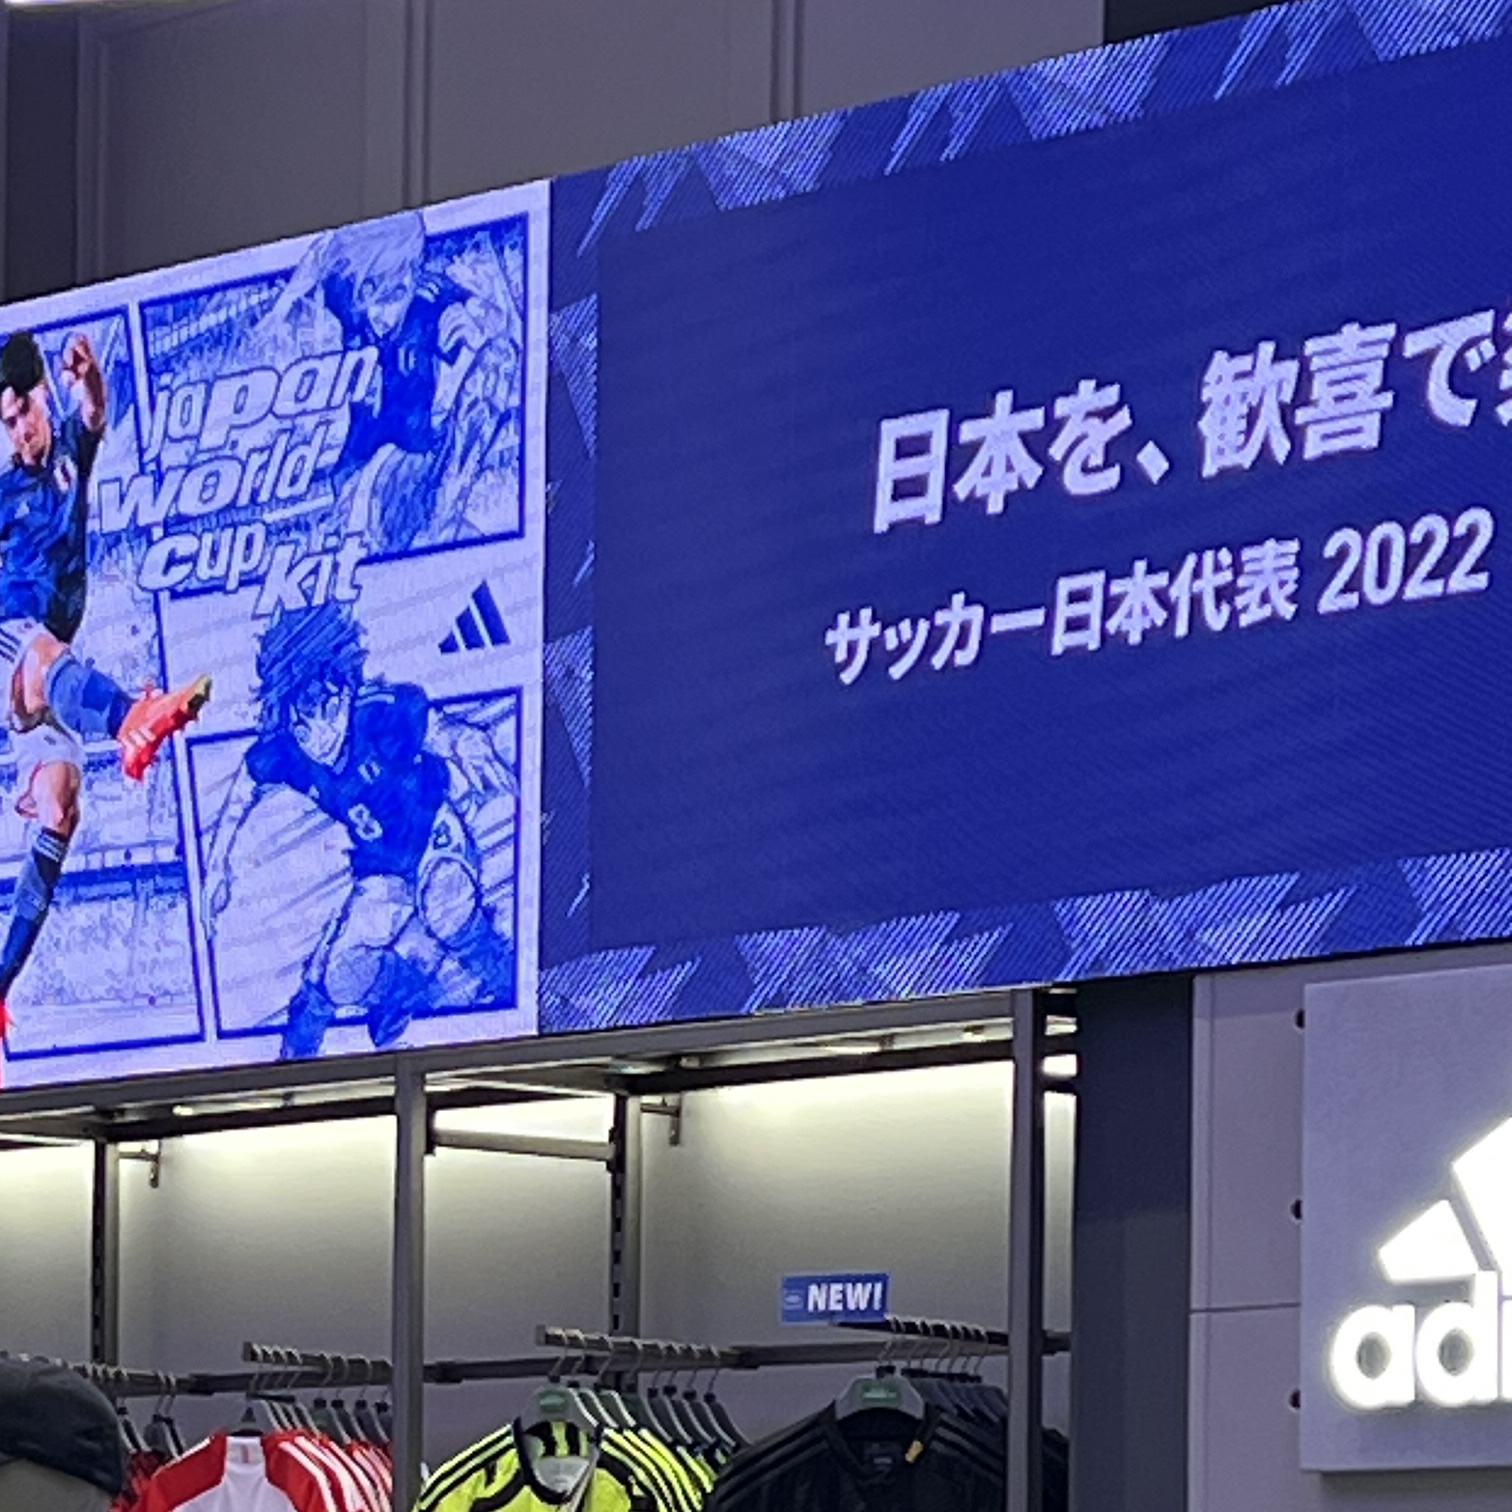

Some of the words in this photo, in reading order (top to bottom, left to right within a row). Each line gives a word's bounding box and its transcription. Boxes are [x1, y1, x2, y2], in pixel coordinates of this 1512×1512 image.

[144, 346, 379, 461] japan
[873, 309, 1512, 533] 日本を、歓喜で
[99, 418, 330, 534] world
[137, 521, 266, 593] cup
[253, 531, 373, 619] kit
[825, 538, 1301, 686] サッカー日本代表
[1317, 507, 1494, 615] 2022
